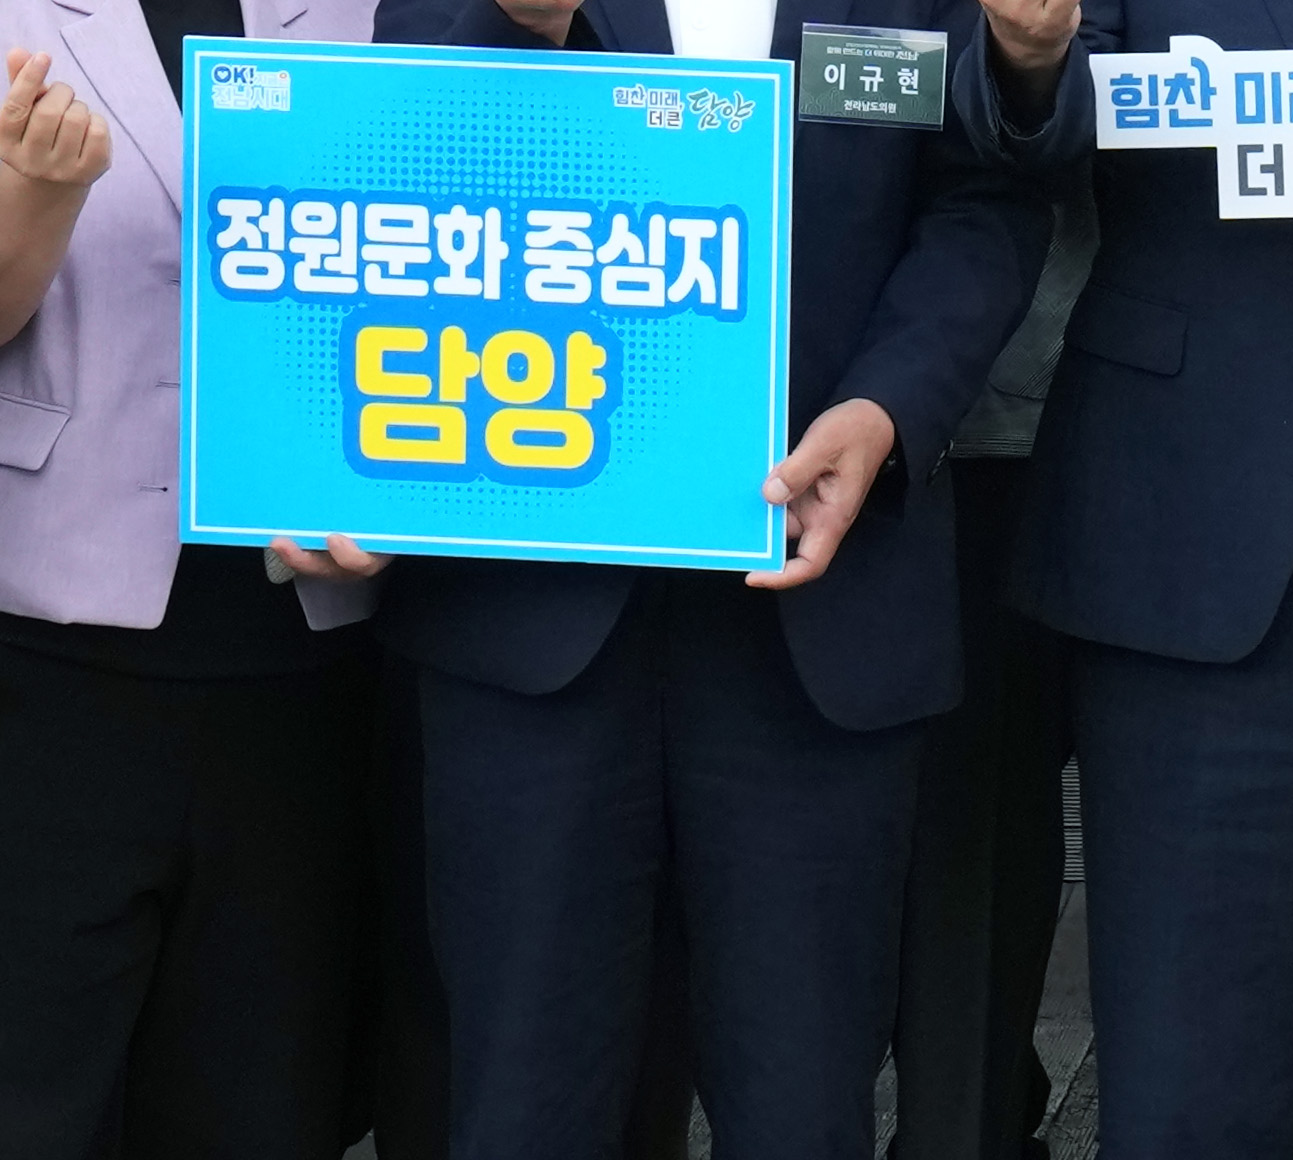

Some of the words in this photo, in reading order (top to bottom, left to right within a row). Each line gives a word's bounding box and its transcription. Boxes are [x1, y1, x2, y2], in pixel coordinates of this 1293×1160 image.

[214, 65, 255, 85] OK!
[1109, 56, 1216, 130] 힘찬
[212, 85, 290, 111] 전남시대
[615, 85, 646, 106] 힘찬
[649, 90, 684, 110] 미래,
[689, 89, 755, 131] 담양
[649, 110, 663, 126] 더
[666, 111, 681, 128] 큰
[1236, 142, 1285, 197] 더
[214, 197, 510, 302] 정원문화
[522, 211, 741, 311] 중심지
[353, 324, 608, 470] 담양
